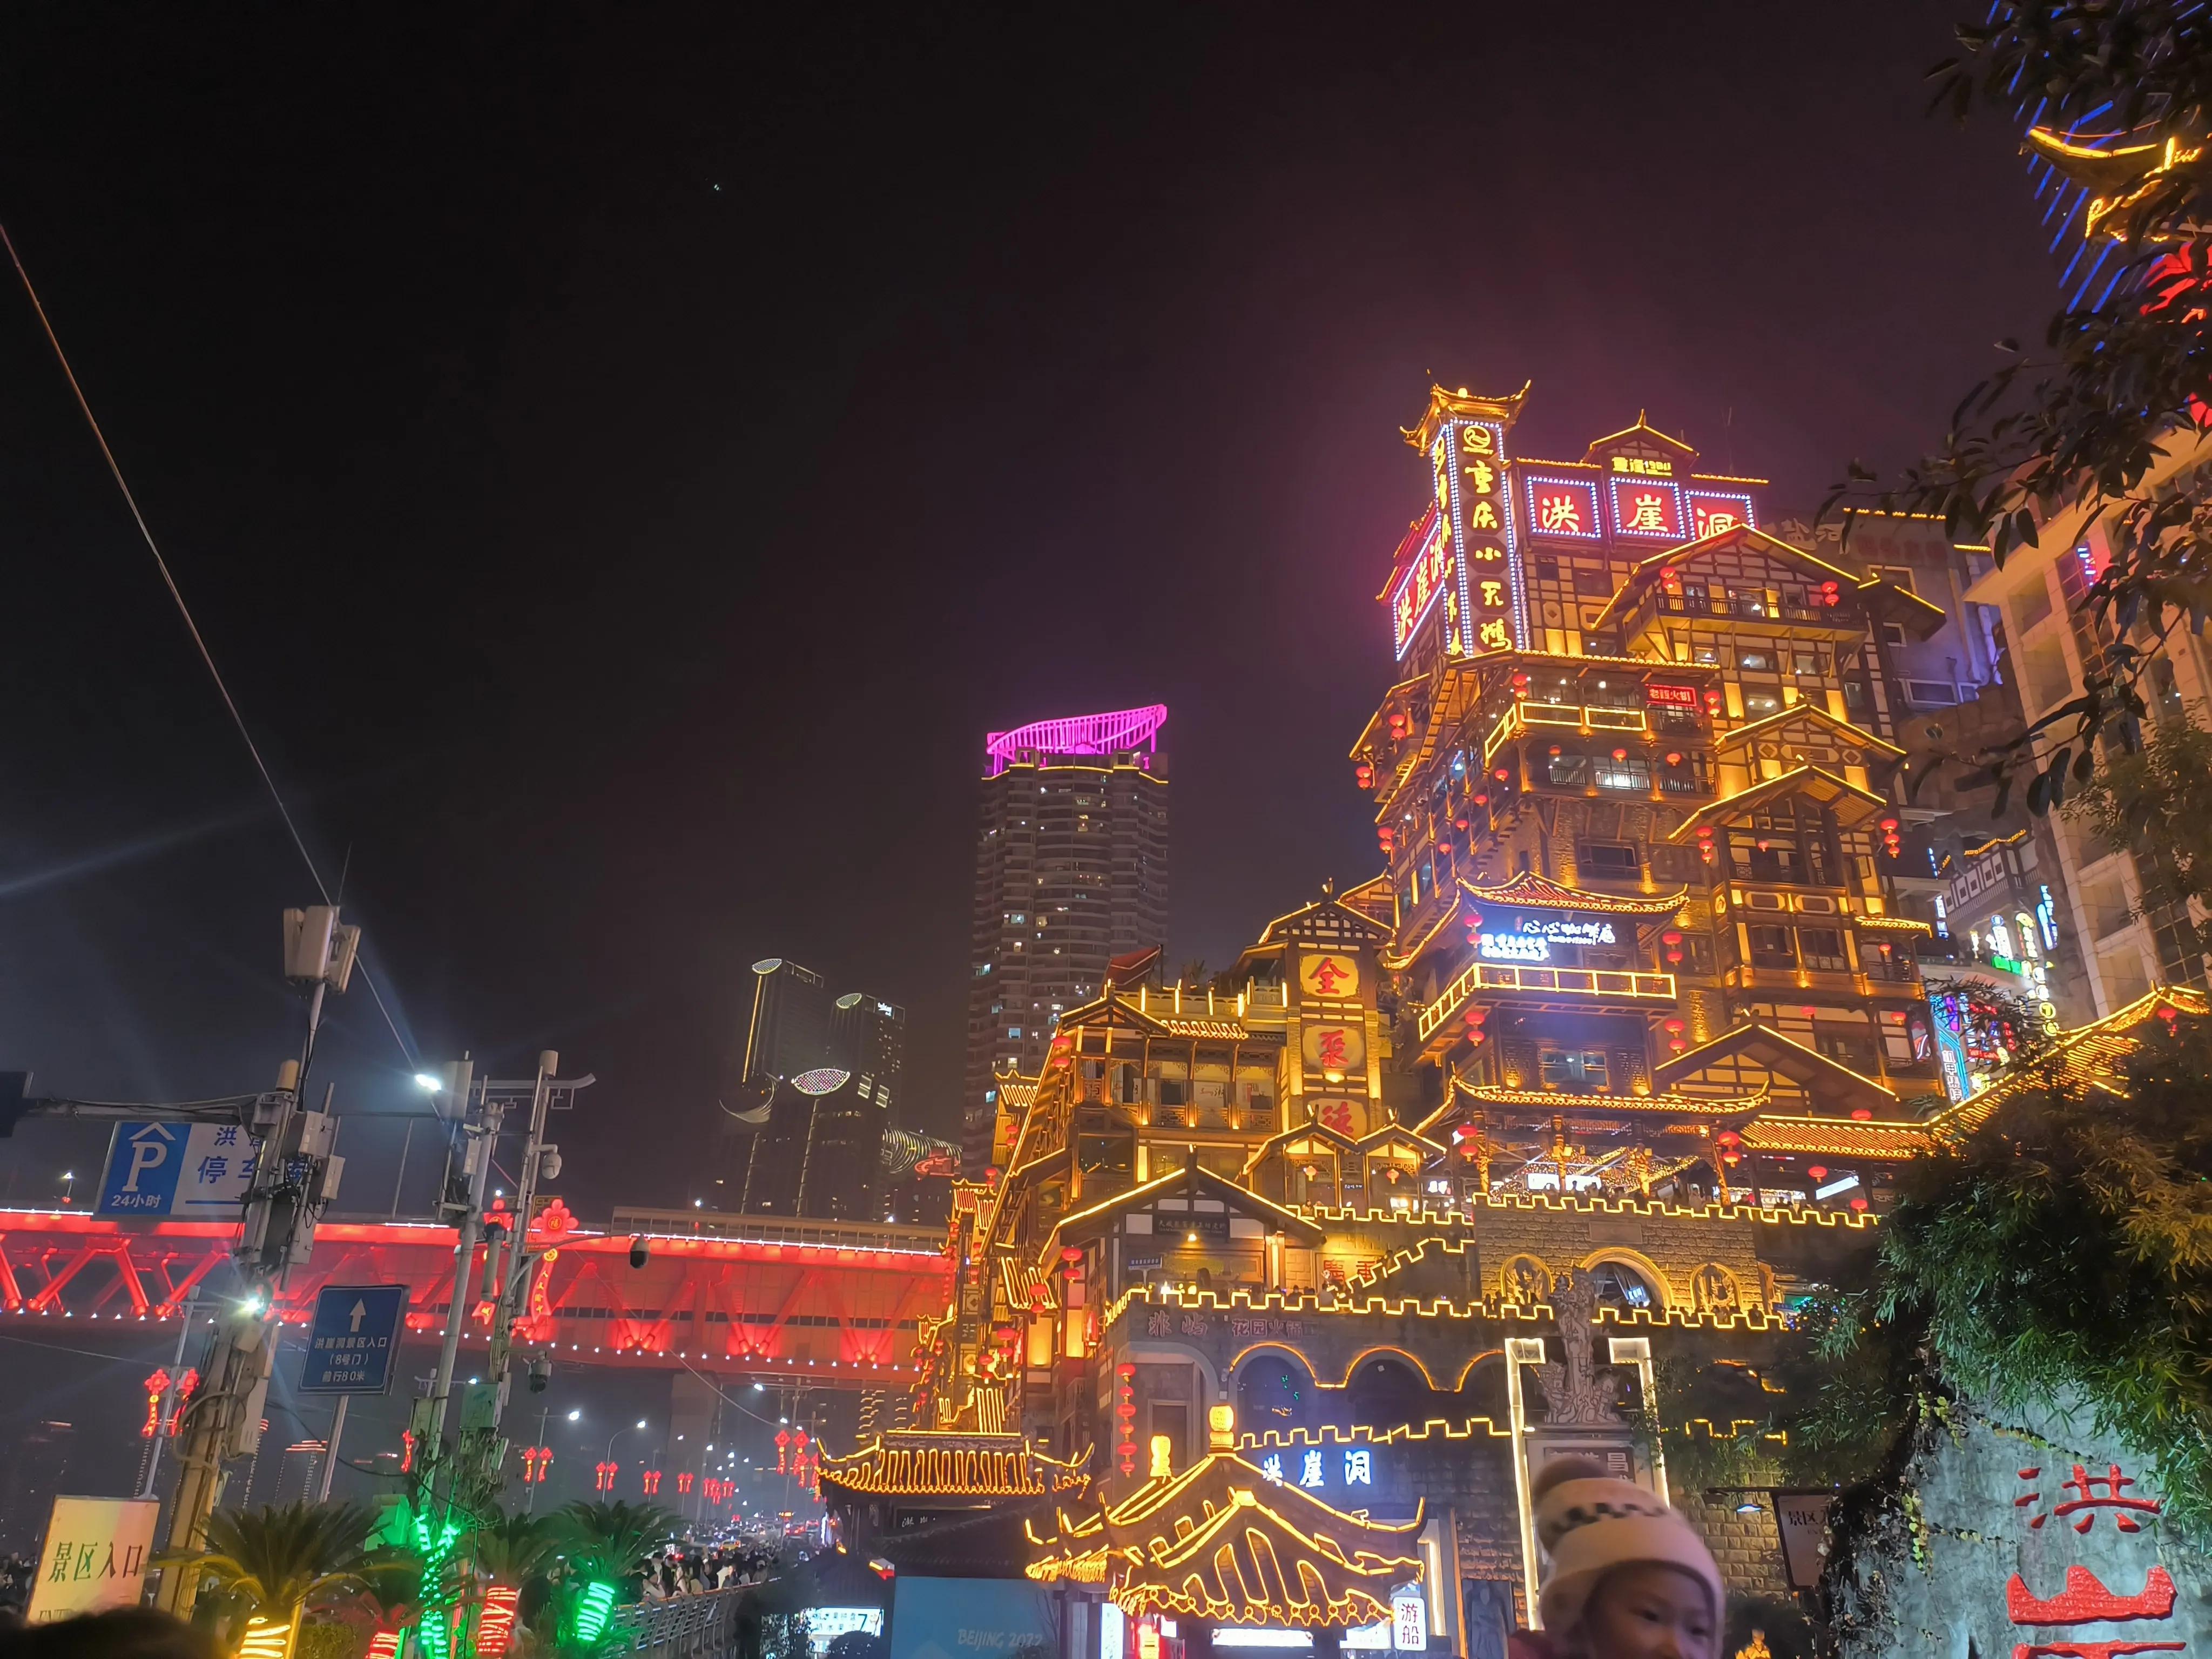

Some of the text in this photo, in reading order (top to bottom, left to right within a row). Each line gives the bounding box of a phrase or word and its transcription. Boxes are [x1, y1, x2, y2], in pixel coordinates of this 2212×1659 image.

[122, 1141, 167, 1191] P
[111, 1194, 161, 1208] 24小时
[315, 1337, 387, 1349] 洪崖洞景区入口
[322, 1371, 365, 1382] 前行80米
[1263, 1449, 1371, 1488] 洪崖洞
[48, 1541, 143, 1583] 景区入口
[1401, 1603, 1419, 1644] 游船
[957, 1628, 1004, 1651] BEIJING
